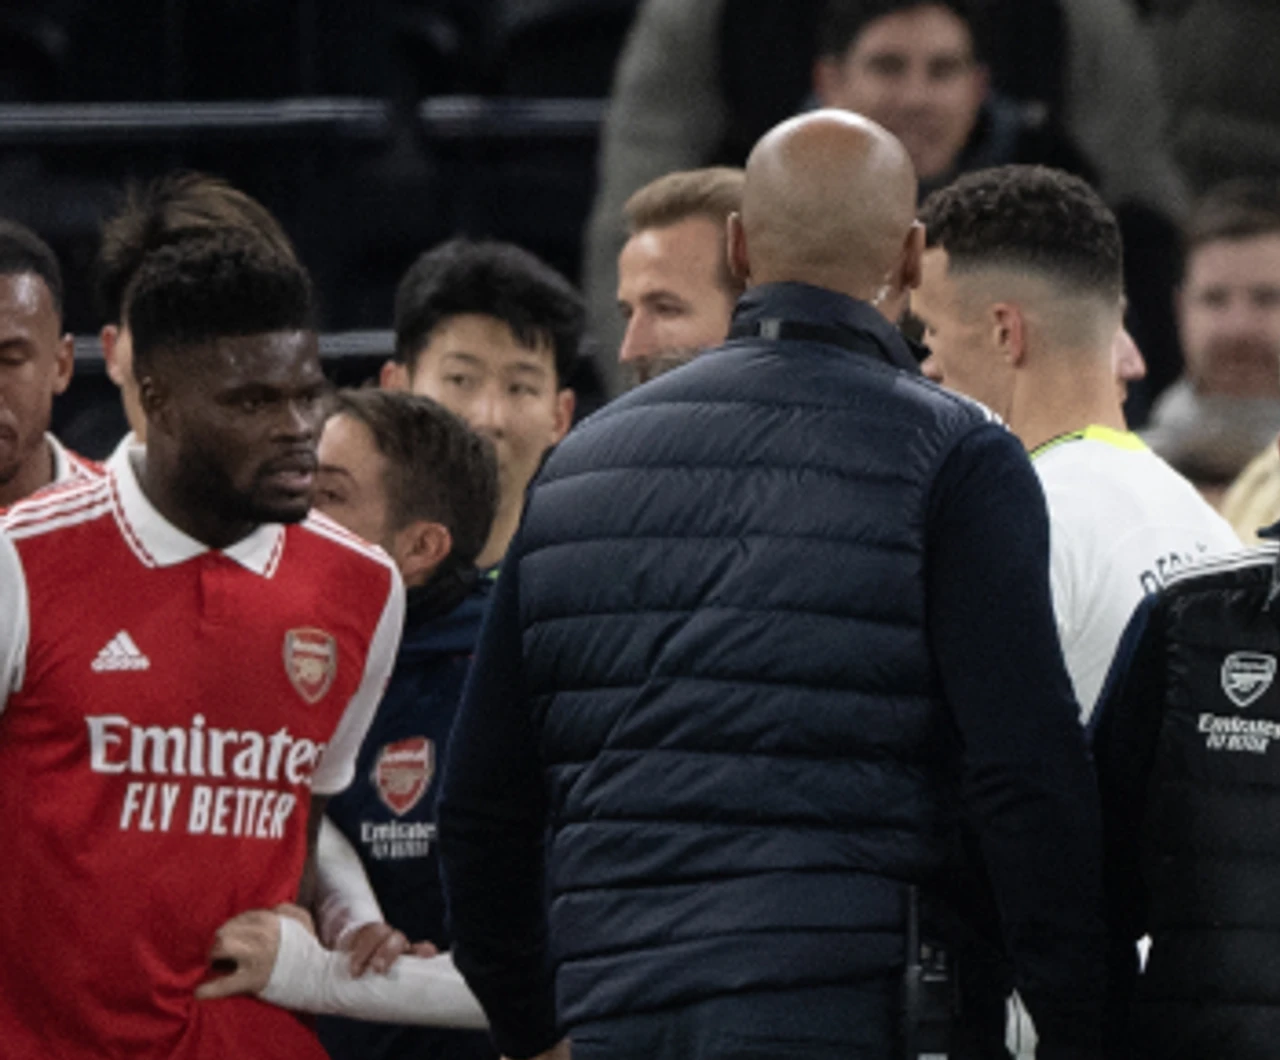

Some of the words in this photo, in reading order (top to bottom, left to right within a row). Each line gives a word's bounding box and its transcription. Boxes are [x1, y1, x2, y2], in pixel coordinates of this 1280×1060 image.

[84, 713, 326, 786] Emirate
[119, 781, 180, 832] FLY
[186, 783, 297, 839] BETTER
